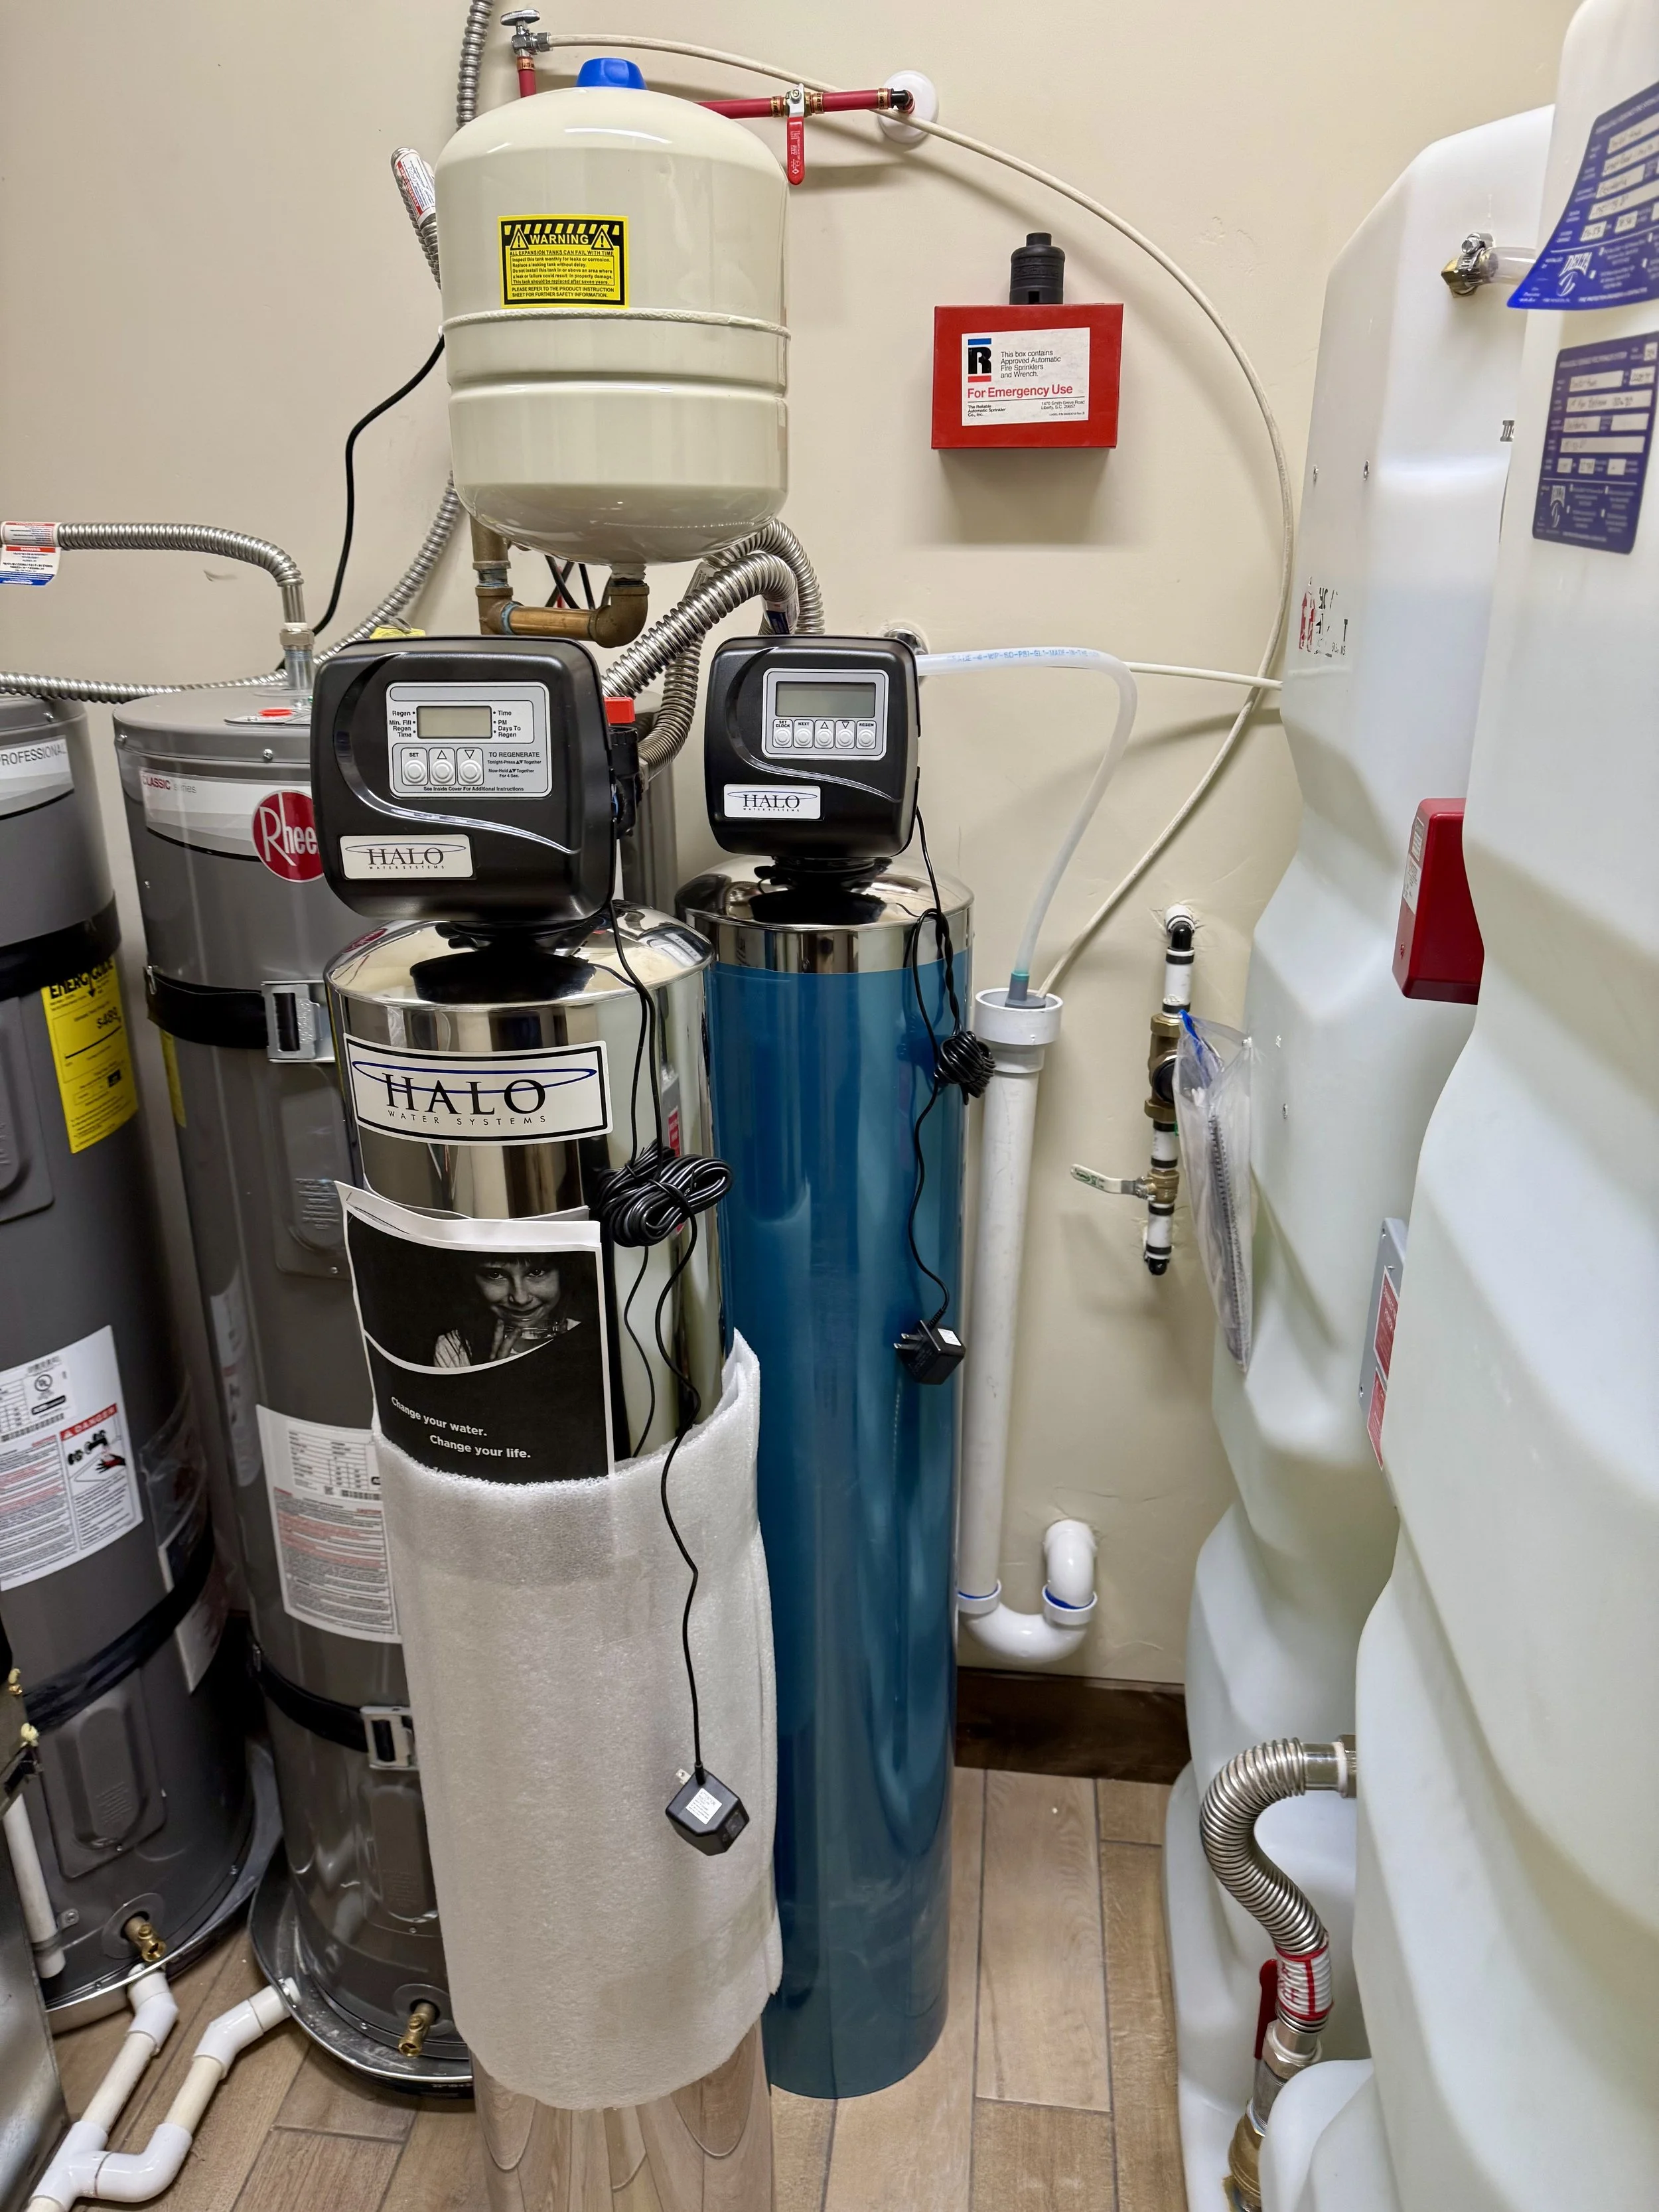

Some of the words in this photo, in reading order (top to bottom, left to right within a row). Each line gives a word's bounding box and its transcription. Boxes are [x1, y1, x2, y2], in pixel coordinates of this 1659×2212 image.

[530, 234, 589, 244] WARNING
[1559, 252, 1593, 277] DELTA
[968, 346, 991, 374] R
[968, 388, 986, 398] For
[988, 387, 1050, 398] Emergency
[1052, 384, 1072, 394] Use
[0, 743, 67, 766] ROFESSIONAL
[142, 775, 171, 790] CLASSIC
[743, 794, 800, 808] HALO
[259, 790, 319, 866] Rhee
[366, 848, 443, 865] HALO
[382, 1073, 545, 1115] HALO
[388, 1110, 439, 1124] WATER
[457, 1116, 545, 1126] SYSTEMS
[391, 1396, 421, 1420] Change
[423, 1415, 447, 1428] your
[450, 1423, 487, 1436] water.
[430, 1435, 472, 1453] Change
[474, 1446, 503, 1455] your
[506, 1448, 531, 1457] life.
